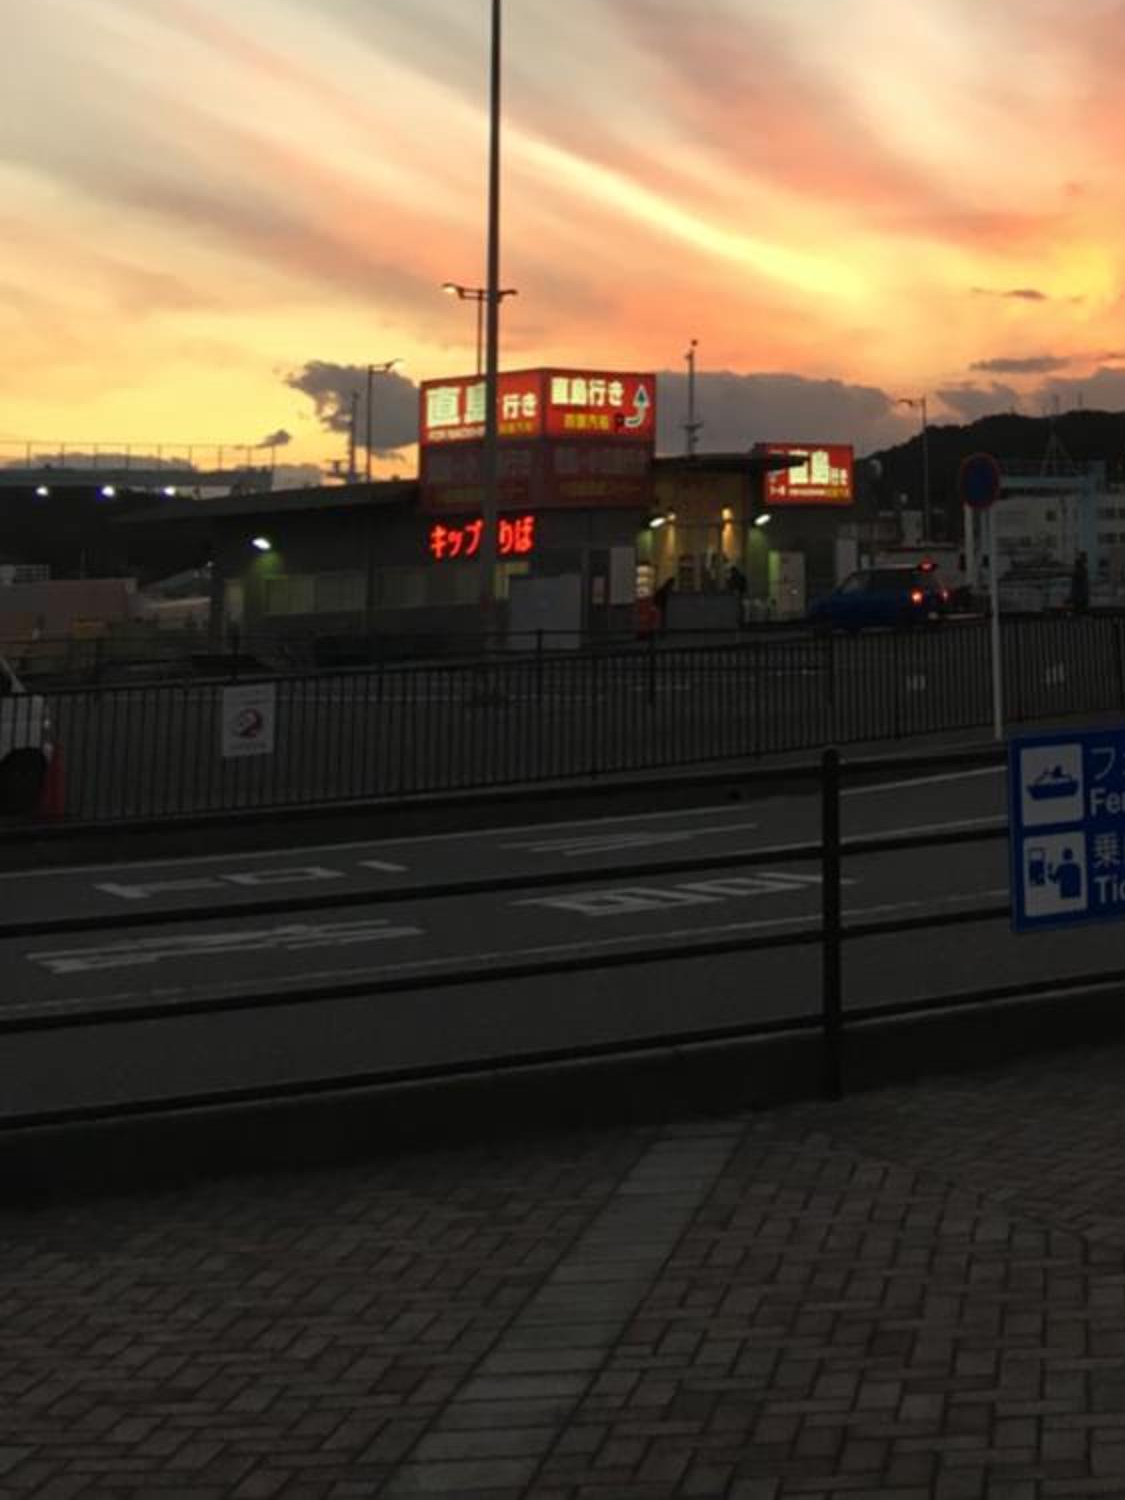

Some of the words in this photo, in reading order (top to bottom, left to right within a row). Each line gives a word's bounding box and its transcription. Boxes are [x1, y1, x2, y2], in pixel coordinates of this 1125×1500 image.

[429, 514, 535, 559] キップりば
